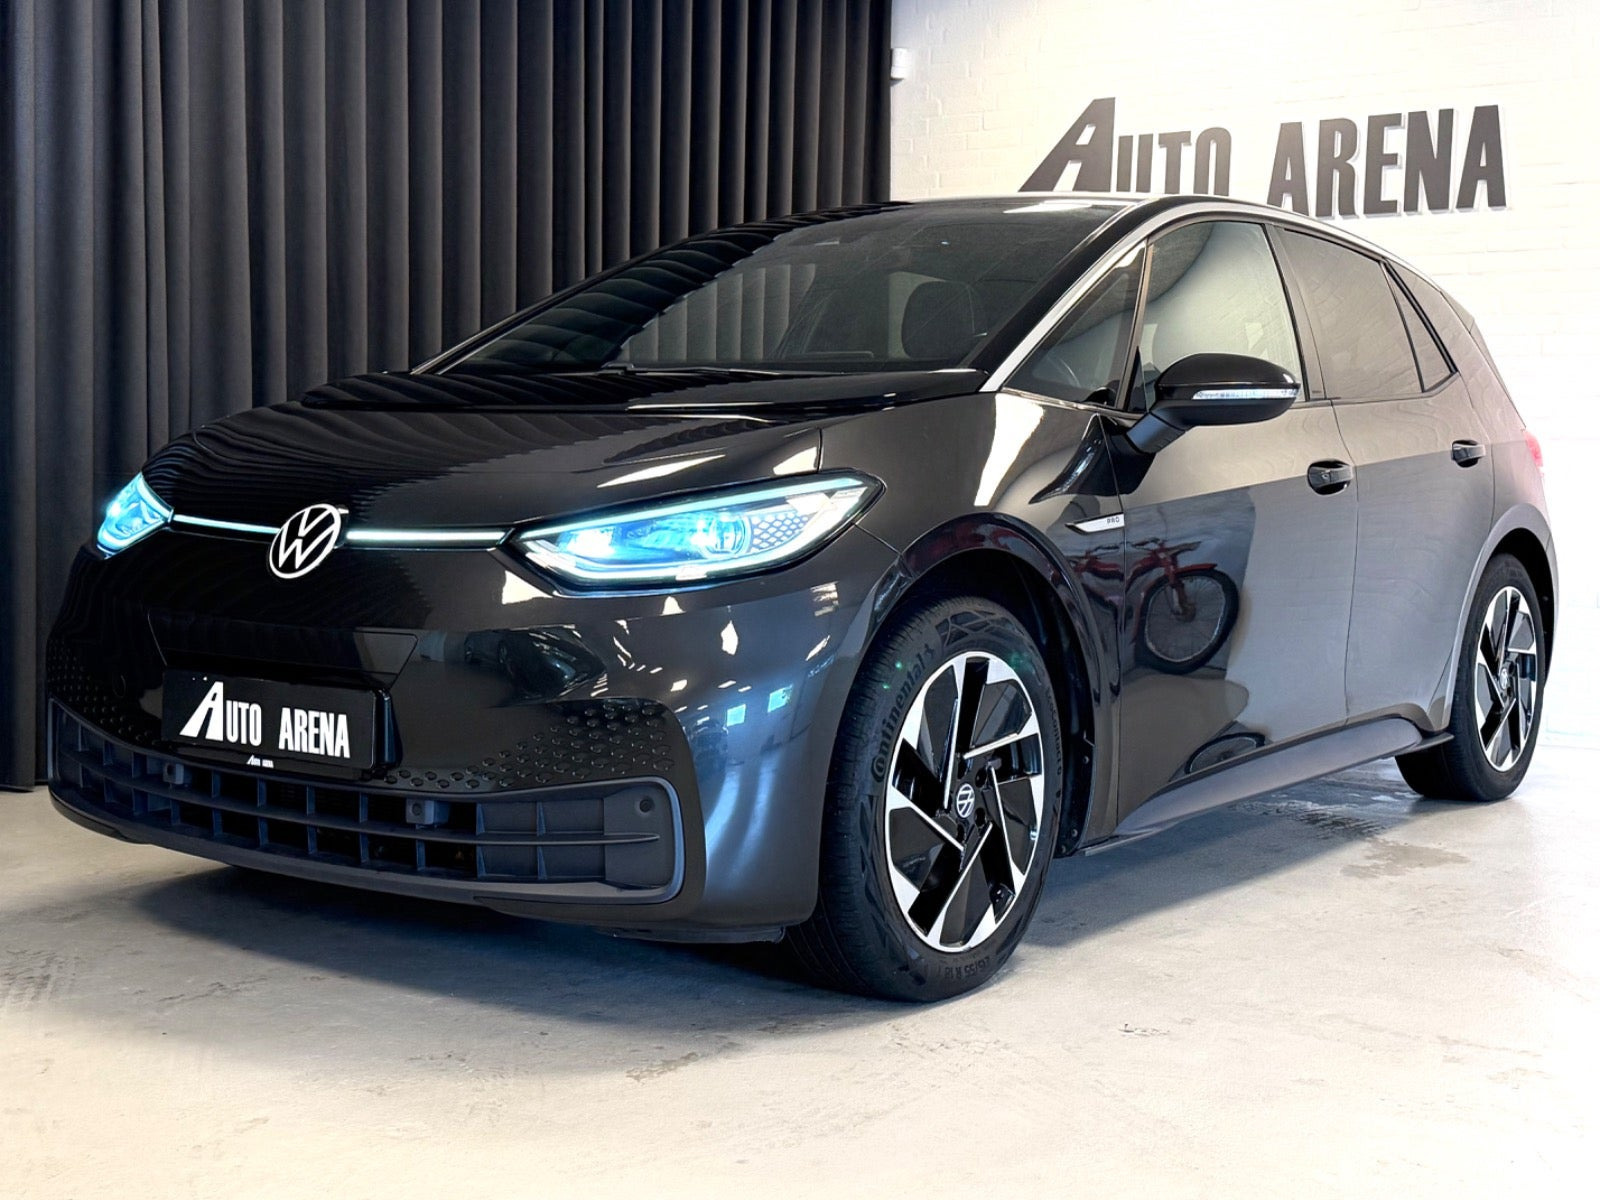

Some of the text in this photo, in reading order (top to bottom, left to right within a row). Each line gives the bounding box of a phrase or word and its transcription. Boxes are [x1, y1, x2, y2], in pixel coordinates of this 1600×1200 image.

[1018, 97, 1507, 217] AUTO ARENA
[179, 681, 350, 758] AUTO ARENA
[871, 652, 926, 783] Continental
